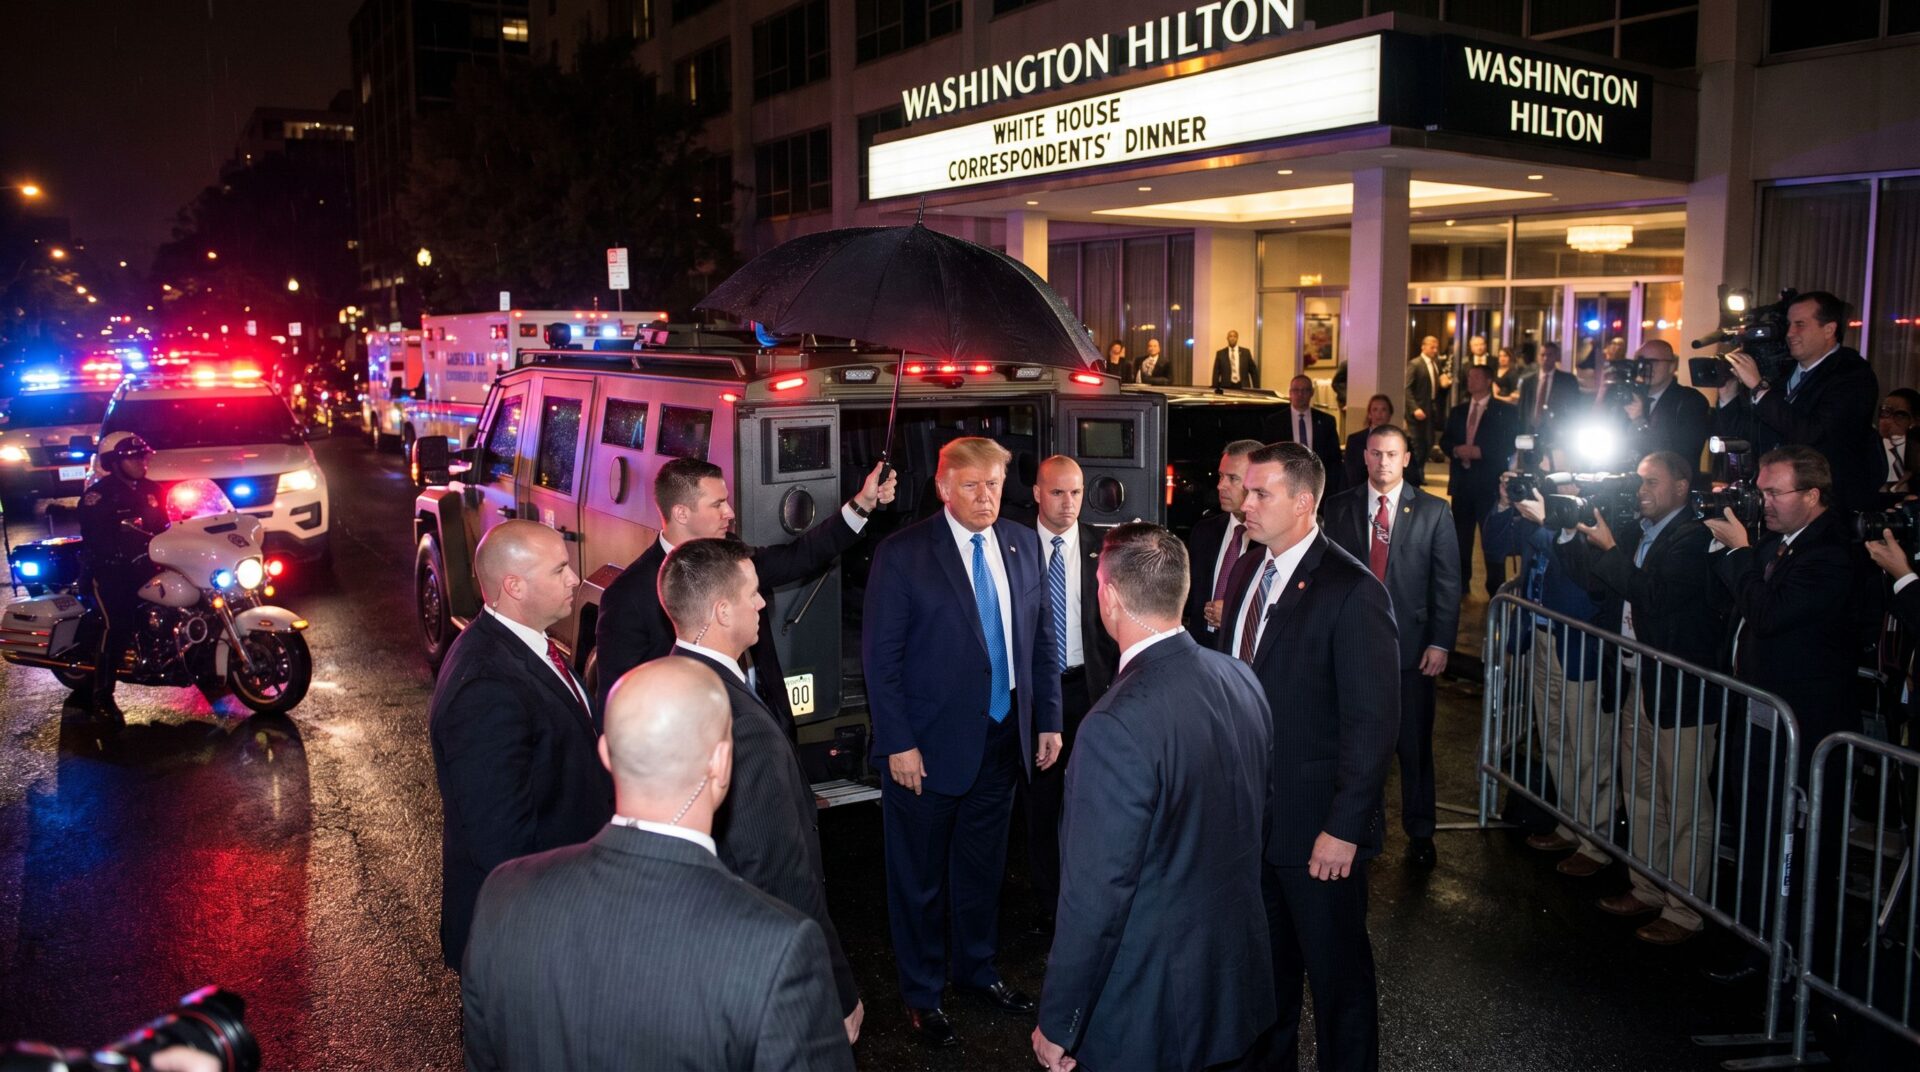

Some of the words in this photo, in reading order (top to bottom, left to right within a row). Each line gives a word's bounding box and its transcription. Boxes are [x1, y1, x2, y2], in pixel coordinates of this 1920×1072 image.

[902, 34, 1110, 122] WASHINGTON
[1128, 0, 1295, 67] HILTON
[1464, 46, 1638, 109] WASHINGTON
[948, 132, 1111, 182] CORRESPONDENTS'
[1125, 116, 1207, 154] DINNER
[992, 114, 1045, 145] WHITE
[1056, 98, 1121, 134] HOUSE
[1510, 99, 1603, 144] HILTON
